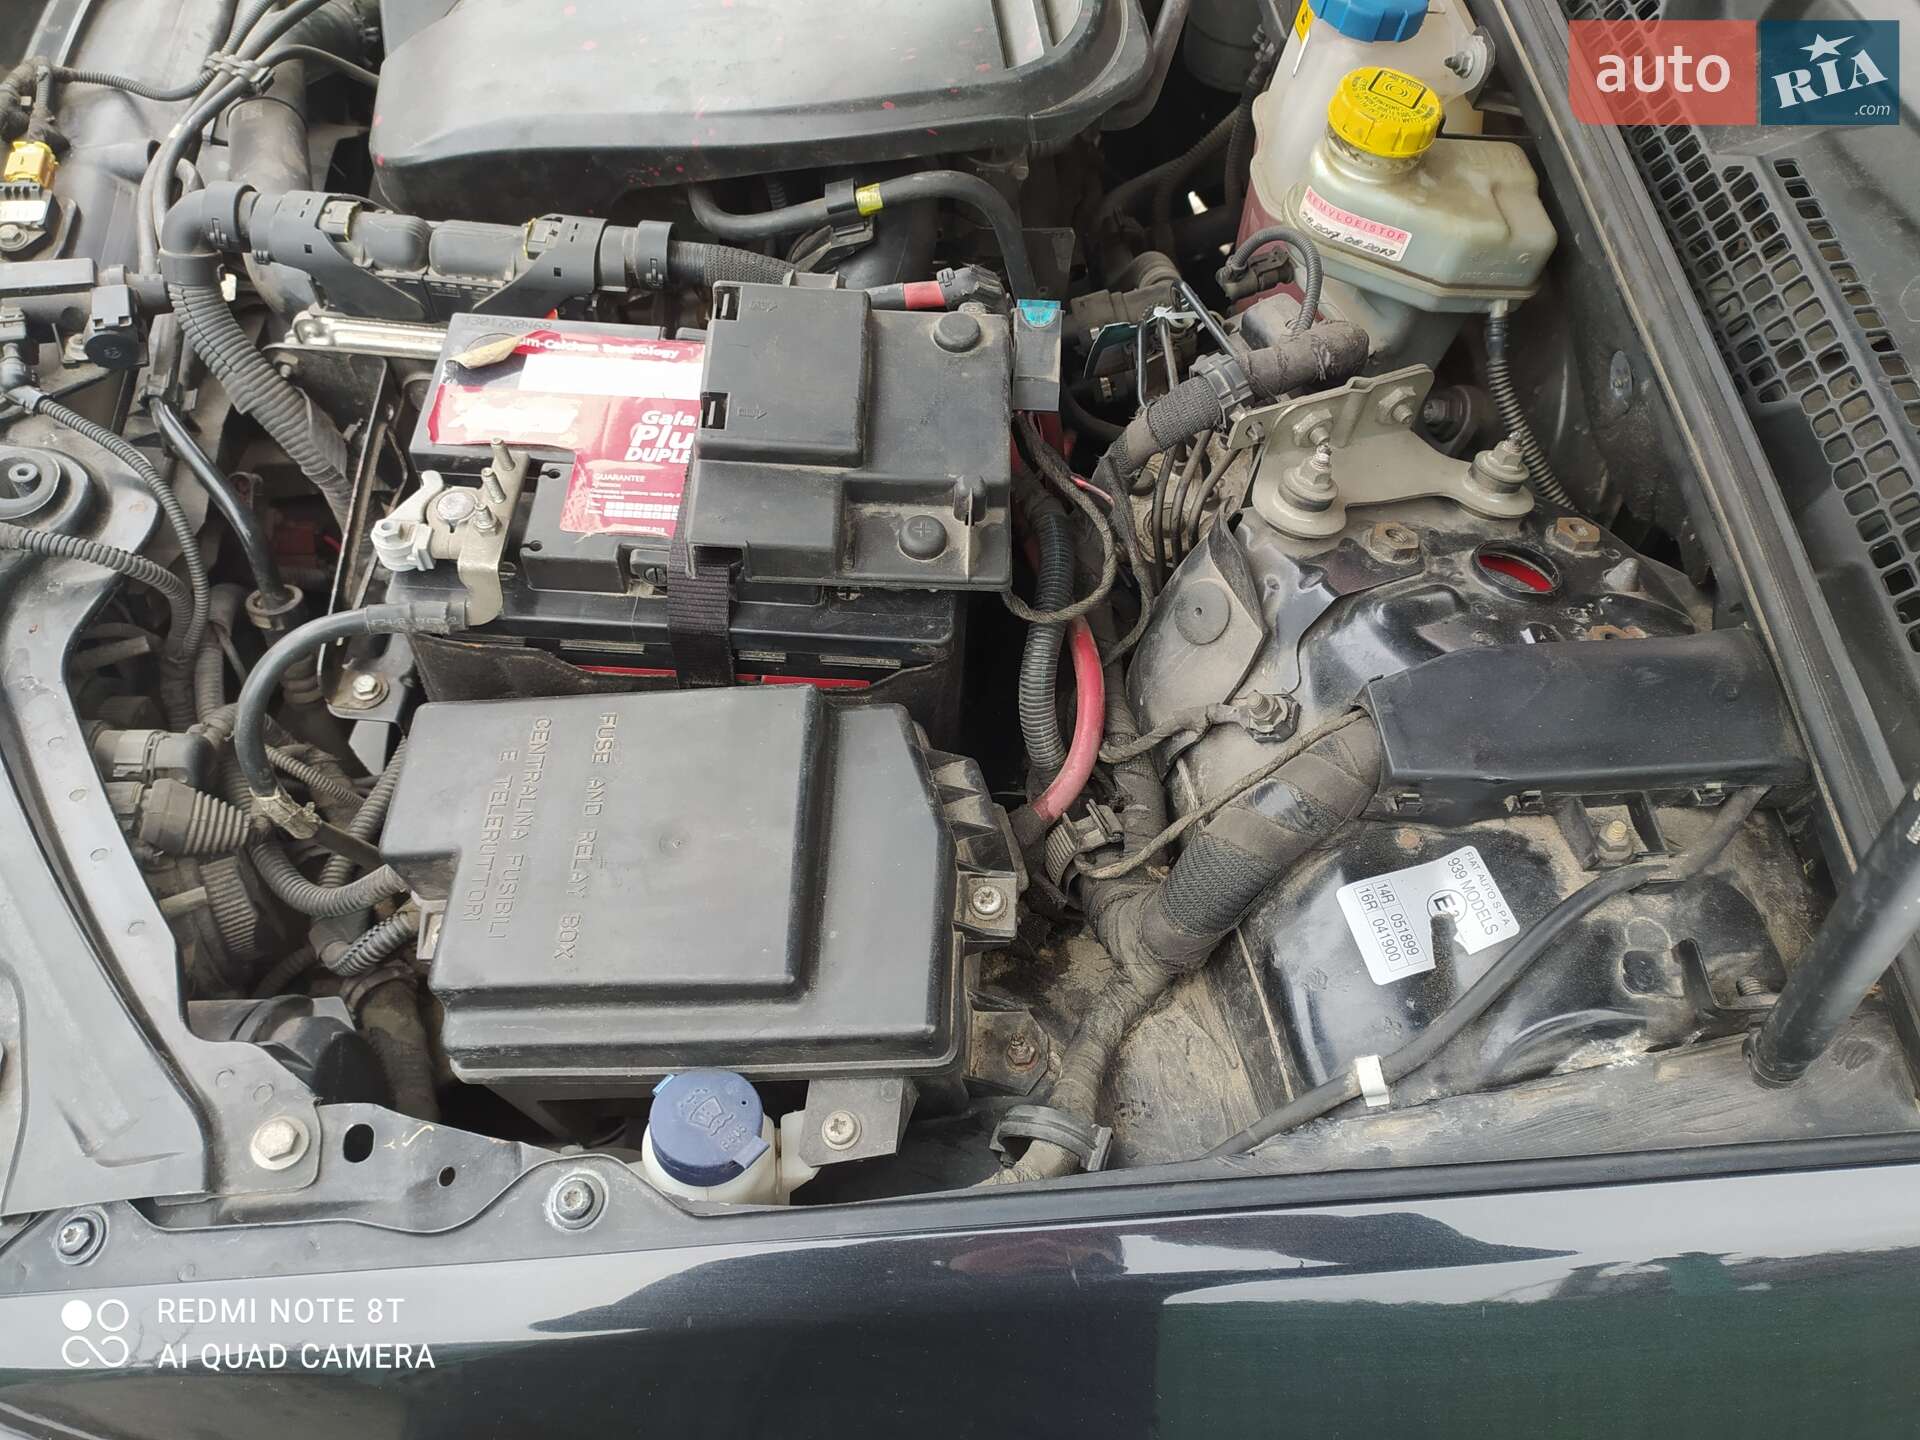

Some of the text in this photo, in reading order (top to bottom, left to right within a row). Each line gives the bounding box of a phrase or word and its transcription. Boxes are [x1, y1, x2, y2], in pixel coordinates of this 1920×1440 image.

[641, 409, 697, 427] Gala
[463, 749, 519, 922] E TELERUTTORI
[488, 717, 552, 940] CENTRALINA FUSIBILI
[554, 712, 618, 960] FUSE AND RELAY BOX
[1447, 856, 1499, 936] 939 MODELS
[1465, 851, 1481, 873] FIAT
[1476, 874, 1497, 900] AUTO
[1358, 886, 1402, 962] 16R 041900
[1374, 883, 1420, 957] 14R 051899
